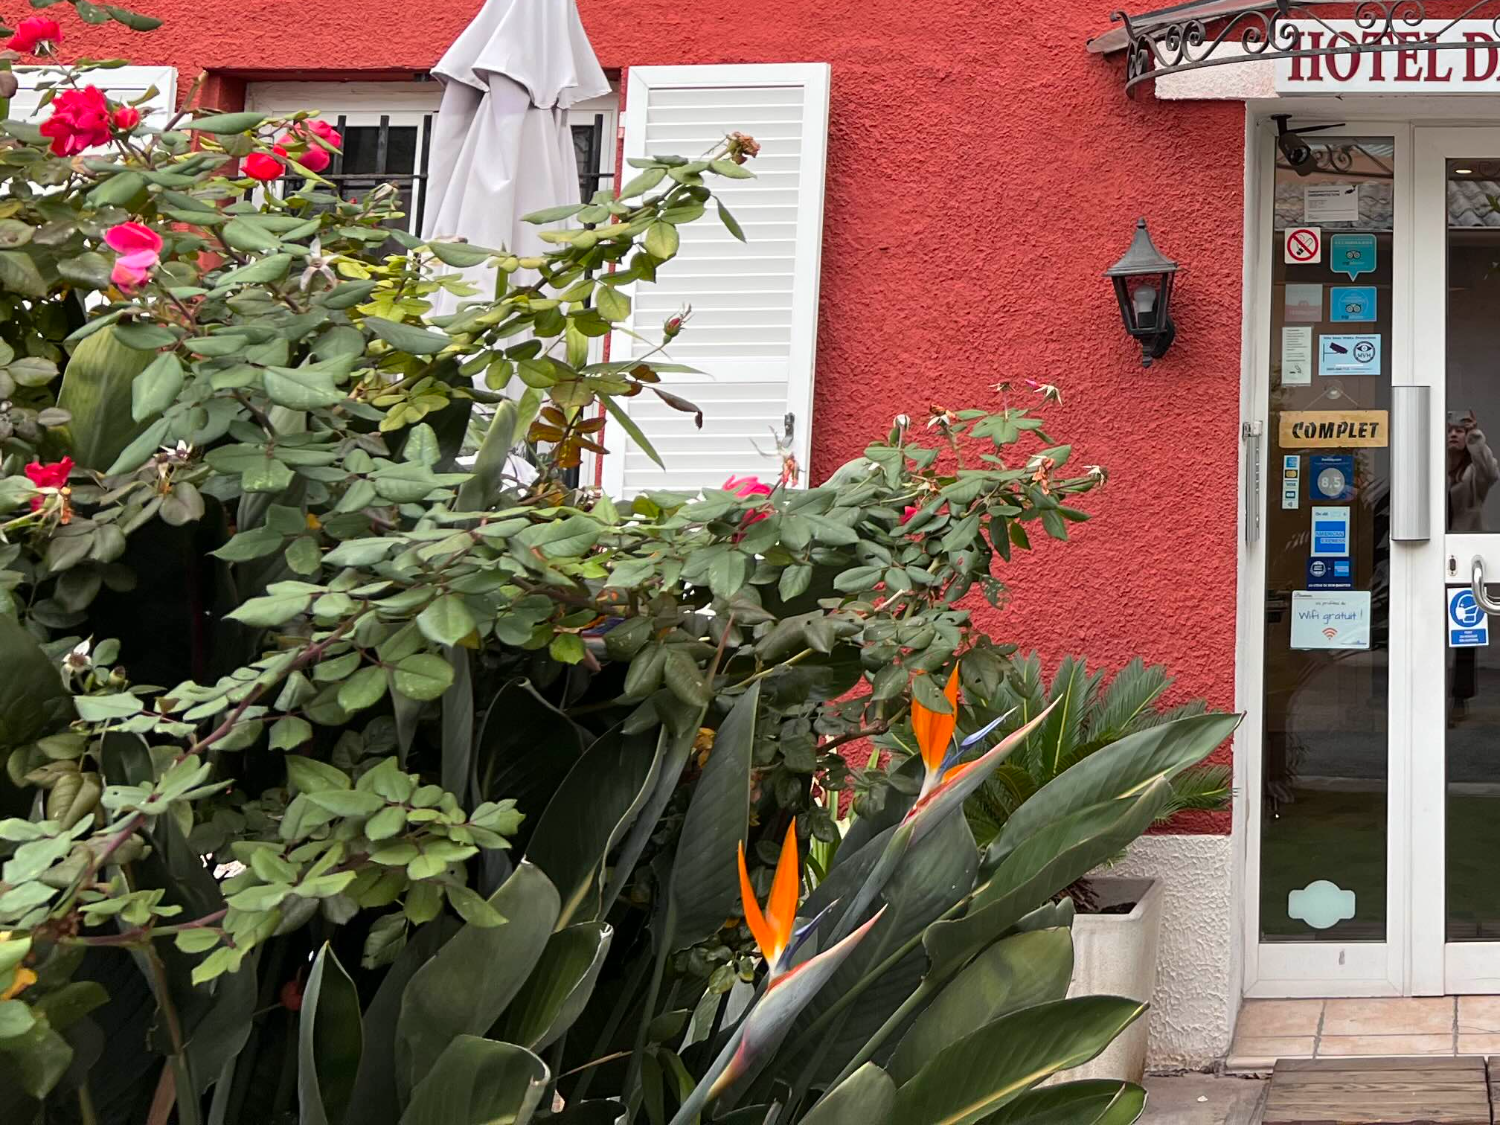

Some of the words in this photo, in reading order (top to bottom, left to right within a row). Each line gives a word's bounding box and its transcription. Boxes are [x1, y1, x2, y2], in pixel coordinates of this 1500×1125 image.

[1287, 30, 1453, 82] HOTEL
[1292, 421, 1380, 440] COMPLET
[1321, 476, 1342, 489] 8,5
[1298, 609, 1320, 620] Wifi
[1322, 610, 1357, 624] gratuit
